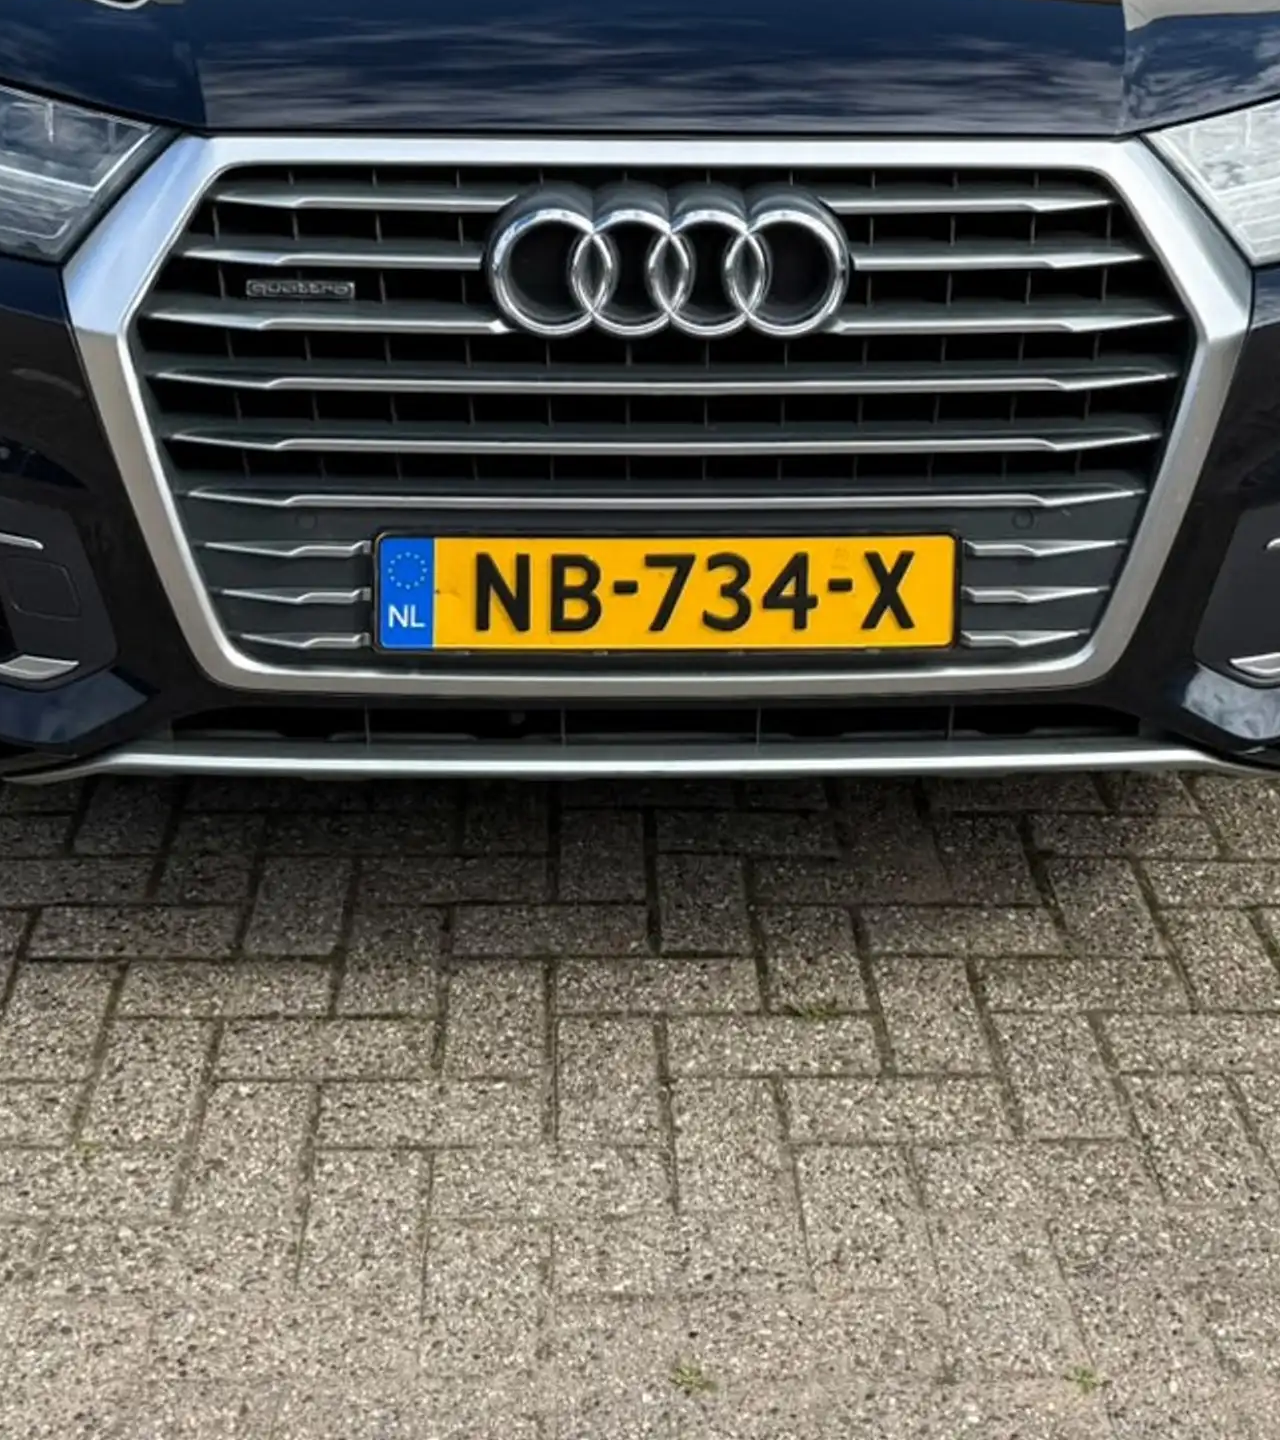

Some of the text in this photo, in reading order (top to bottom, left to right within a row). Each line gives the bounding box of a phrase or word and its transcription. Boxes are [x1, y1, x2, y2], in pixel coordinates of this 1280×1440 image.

[250, 281, 350, 297] quattro
[387, 550, 916, 633] NL NB-734-X
